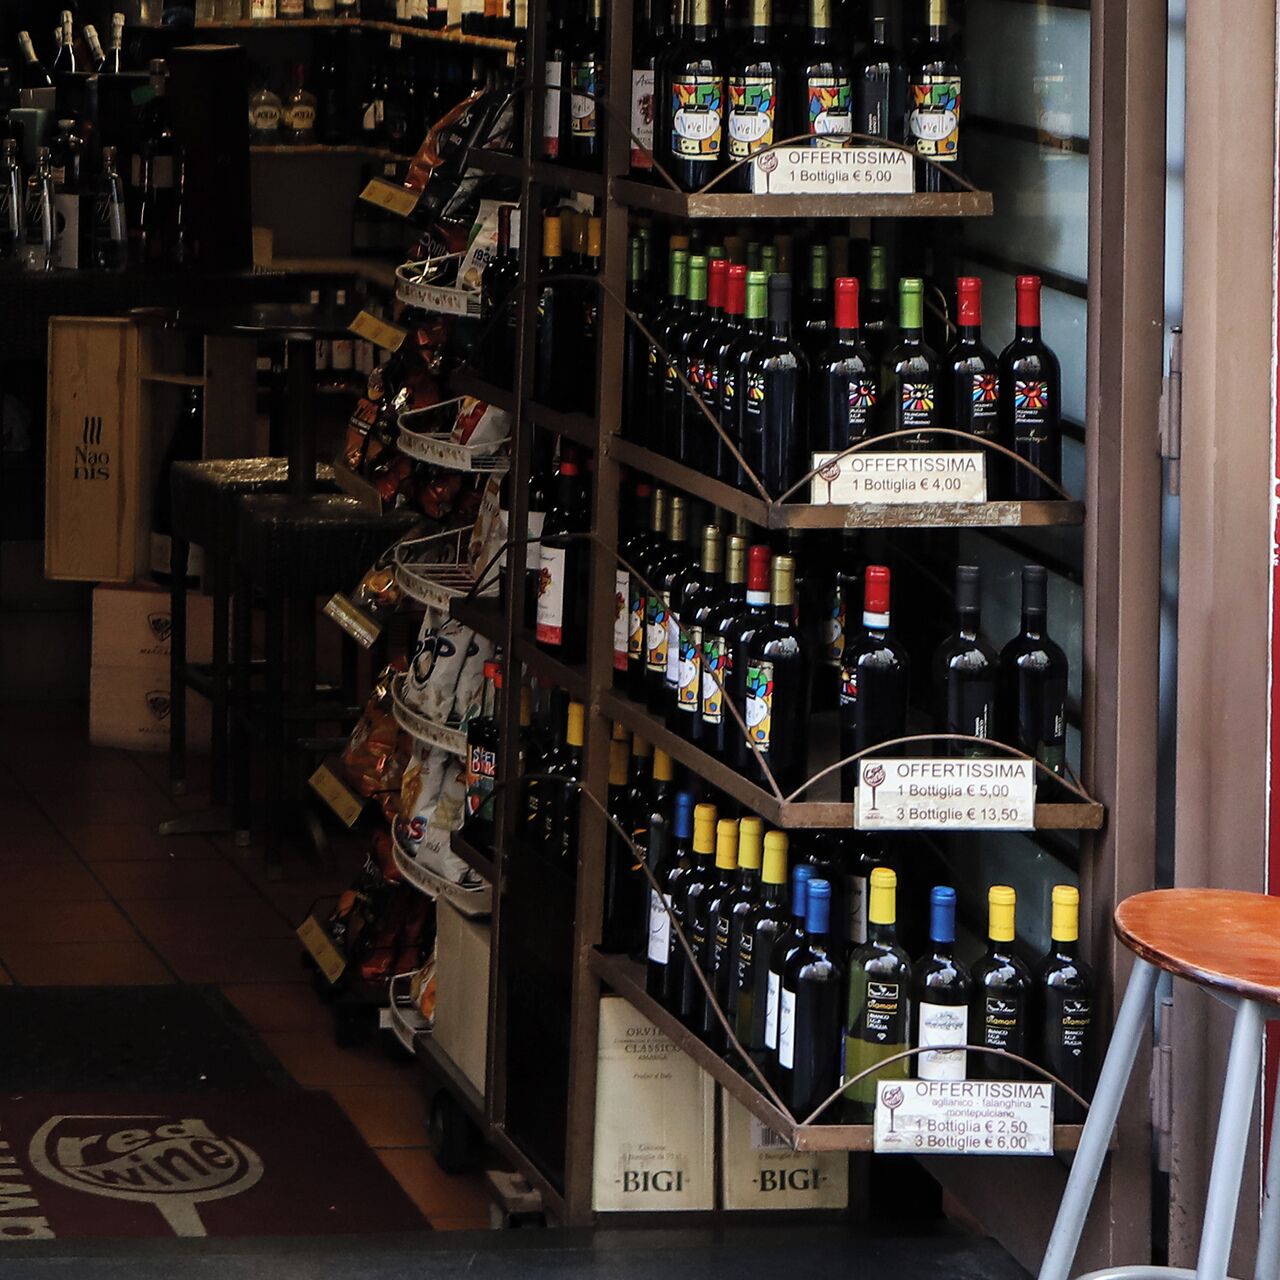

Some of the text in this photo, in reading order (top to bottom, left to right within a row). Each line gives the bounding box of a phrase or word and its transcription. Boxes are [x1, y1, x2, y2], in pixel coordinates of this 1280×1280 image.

[788, 151, 907, 165] OFFERTISSIMA
[790, 170, 892, 184] 1 Bottiglia € 5,00
[851, 458, 977, 473] OFFERTISSIMA
[853, 478, 962, 493] 1 Bottiglia € 4,00
[897, 763, 1026, 778] OFFERTISSIMA
[898, 784, 1009, 799] 1 Bottiglia € 5,00
[897, 807, 1018, 822] 3 Bottiglie € 13,50
[915, 1082, 1045, 1099] OFFERTISSIMA
[931, 1098, 973, 1108] aglianico
[982, 1098, 1032, 1109] falanghina
[946, 1109, 1015, 1119] montepulciano
[915, 1119, 1028, 1135] 1 Bottiglia € 2,50
[57, 1119, 221, 1167] red
[915, 1135, 1028, 1150] 3 Bottiglie € 6,00
[78, 1137, 236, 1188] wine
[623, 1170, 684, 1193] BIGI
[759, 1168, 820, 1192] BIGI
